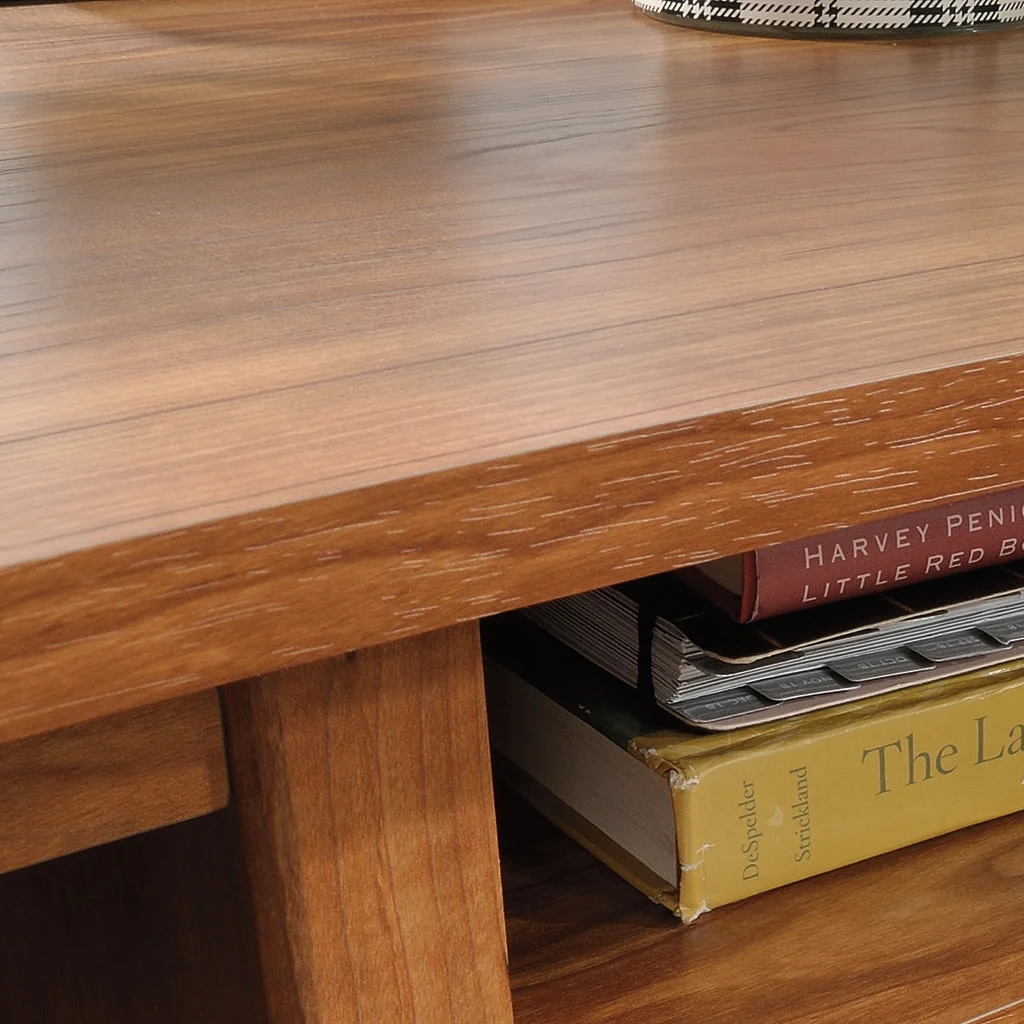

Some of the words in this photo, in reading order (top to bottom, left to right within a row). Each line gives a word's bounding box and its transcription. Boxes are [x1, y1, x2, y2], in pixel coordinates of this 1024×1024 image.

[802, 563, 910, 603] LITTLE
[925, 547, 984, 575] RED
[804, 523, 930, 569] HARVEY
[861, 731, 958, 795] The
[738, 780, 763, 881] DeSpelder
[789, 765, 812, 862] Strickland
